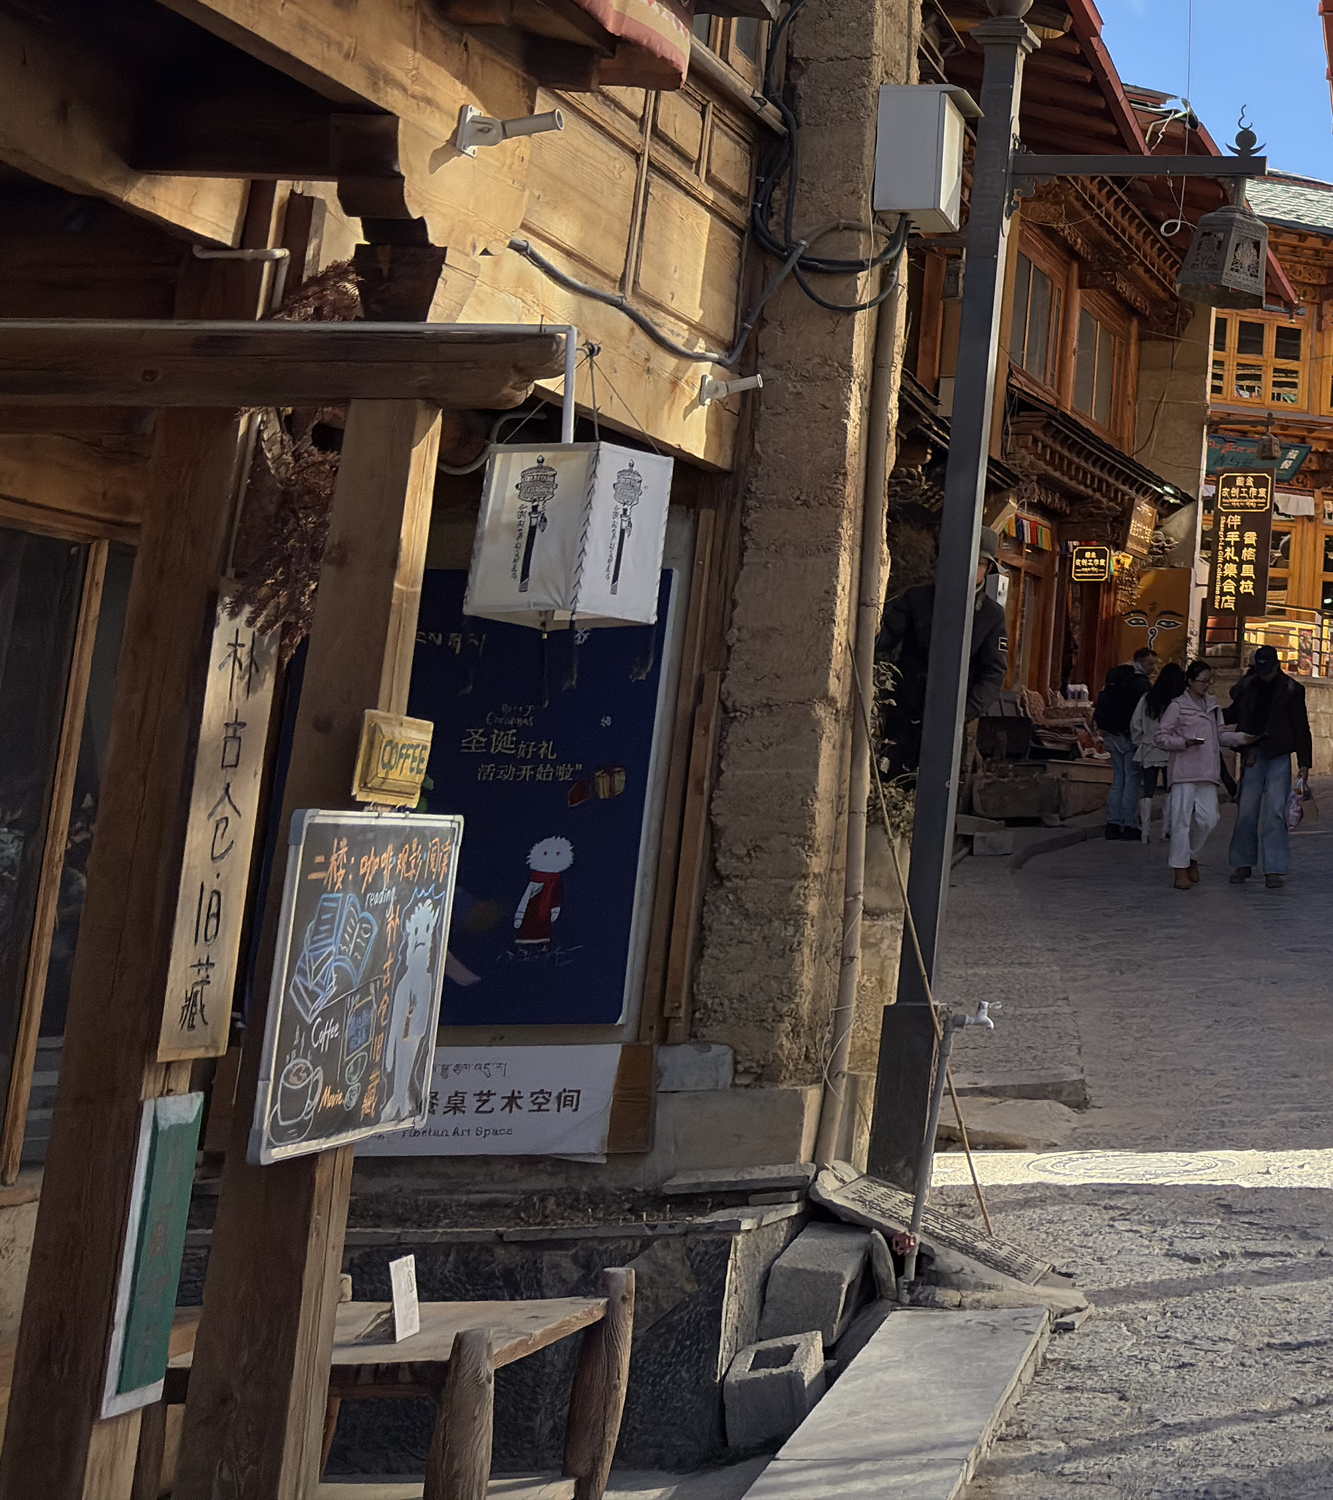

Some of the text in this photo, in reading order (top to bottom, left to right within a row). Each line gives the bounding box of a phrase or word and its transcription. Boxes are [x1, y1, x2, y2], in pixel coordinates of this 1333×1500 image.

[1220, 514, 1242, 612] 伴手礼集合店
[1239, 531, 1258, 596] 香格里拉
[381, 739, 428, 776] COFFEE
[460, 728, 558, 760] 圣诞好礼
[311, 1017, 341, 1053] Coffee
[318, 1085, 344, 1113] Movie
[452, 1126, 471, 1137] Art
[475, 1126, 514, 1139] Space
